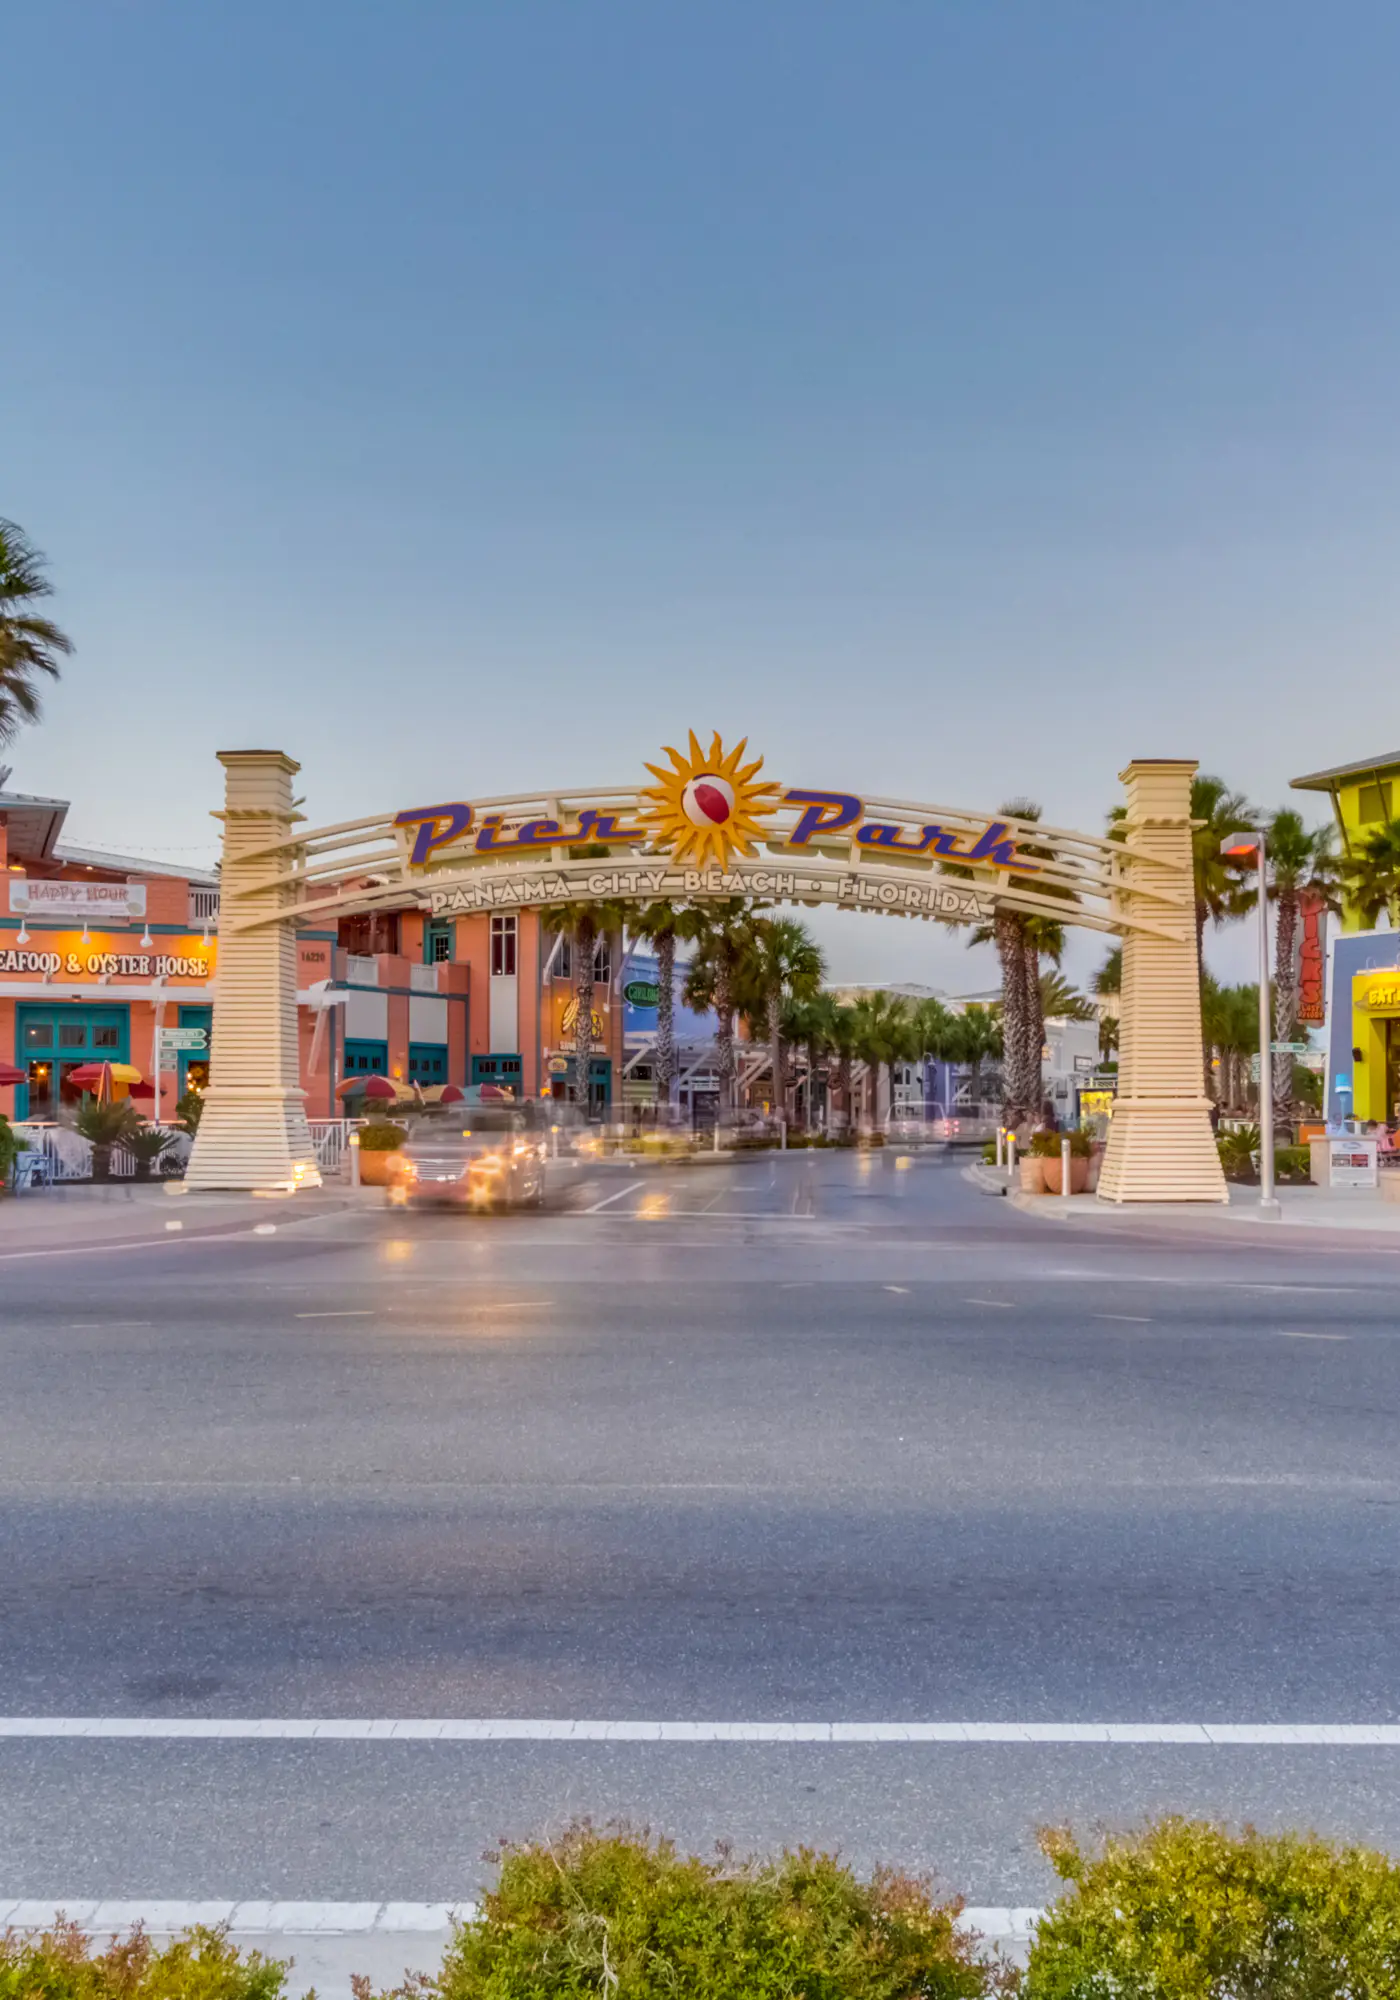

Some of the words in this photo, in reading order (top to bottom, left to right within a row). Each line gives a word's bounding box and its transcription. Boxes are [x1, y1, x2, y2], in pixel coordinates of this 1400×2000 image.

[393, 801, 647, 869] Pier
[780, 788, 1042, 873] Park
[27, 884, 81, 902] HAPPY
[86, 886, 129, 902] HOUR
[430, 876, 571, 913] PANAMA
[587, 870, 667, 896] CITY
[684, 870, 795, 895] BEACH
[837, 878, 983, 918] FLORIDA
[66, 953, 82, 973] &
[87, 954, 150, 976] OYSTER
[155, 957, 208, 976] HOUSE
[1368, 988, 1396, 1005] EAT
